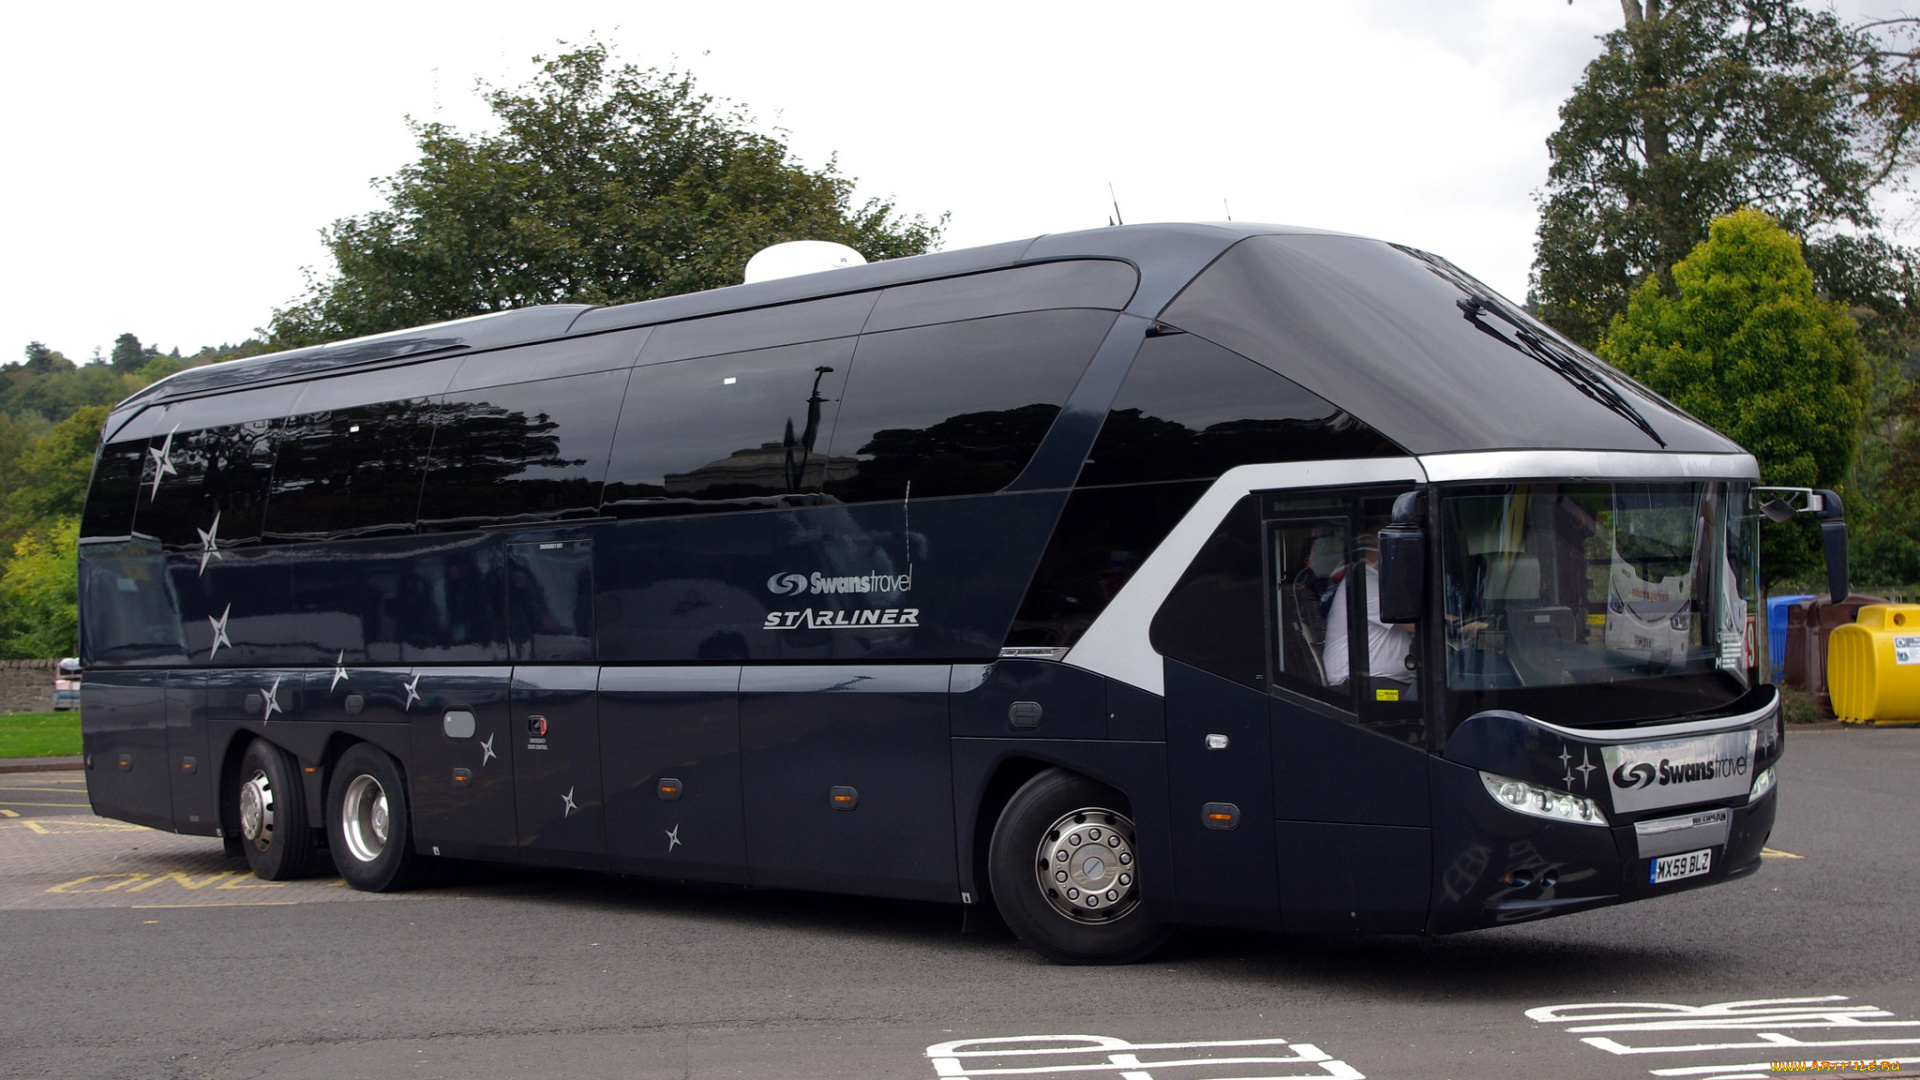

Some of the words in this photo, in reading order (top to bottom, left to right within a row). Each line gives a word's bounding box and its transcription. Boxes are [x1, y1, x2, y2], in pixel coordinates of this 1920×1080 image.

[810, 563, 913, 595] Swanstravel
[763, 607, 920, 630] STARLINER
[1658, 744, 1748, 786] Swanstravel
[1656, 857, 1687, 880] MX59
[1689, 852, 1710, 874] BLZ
[45, 871, 348, 893] ONL
